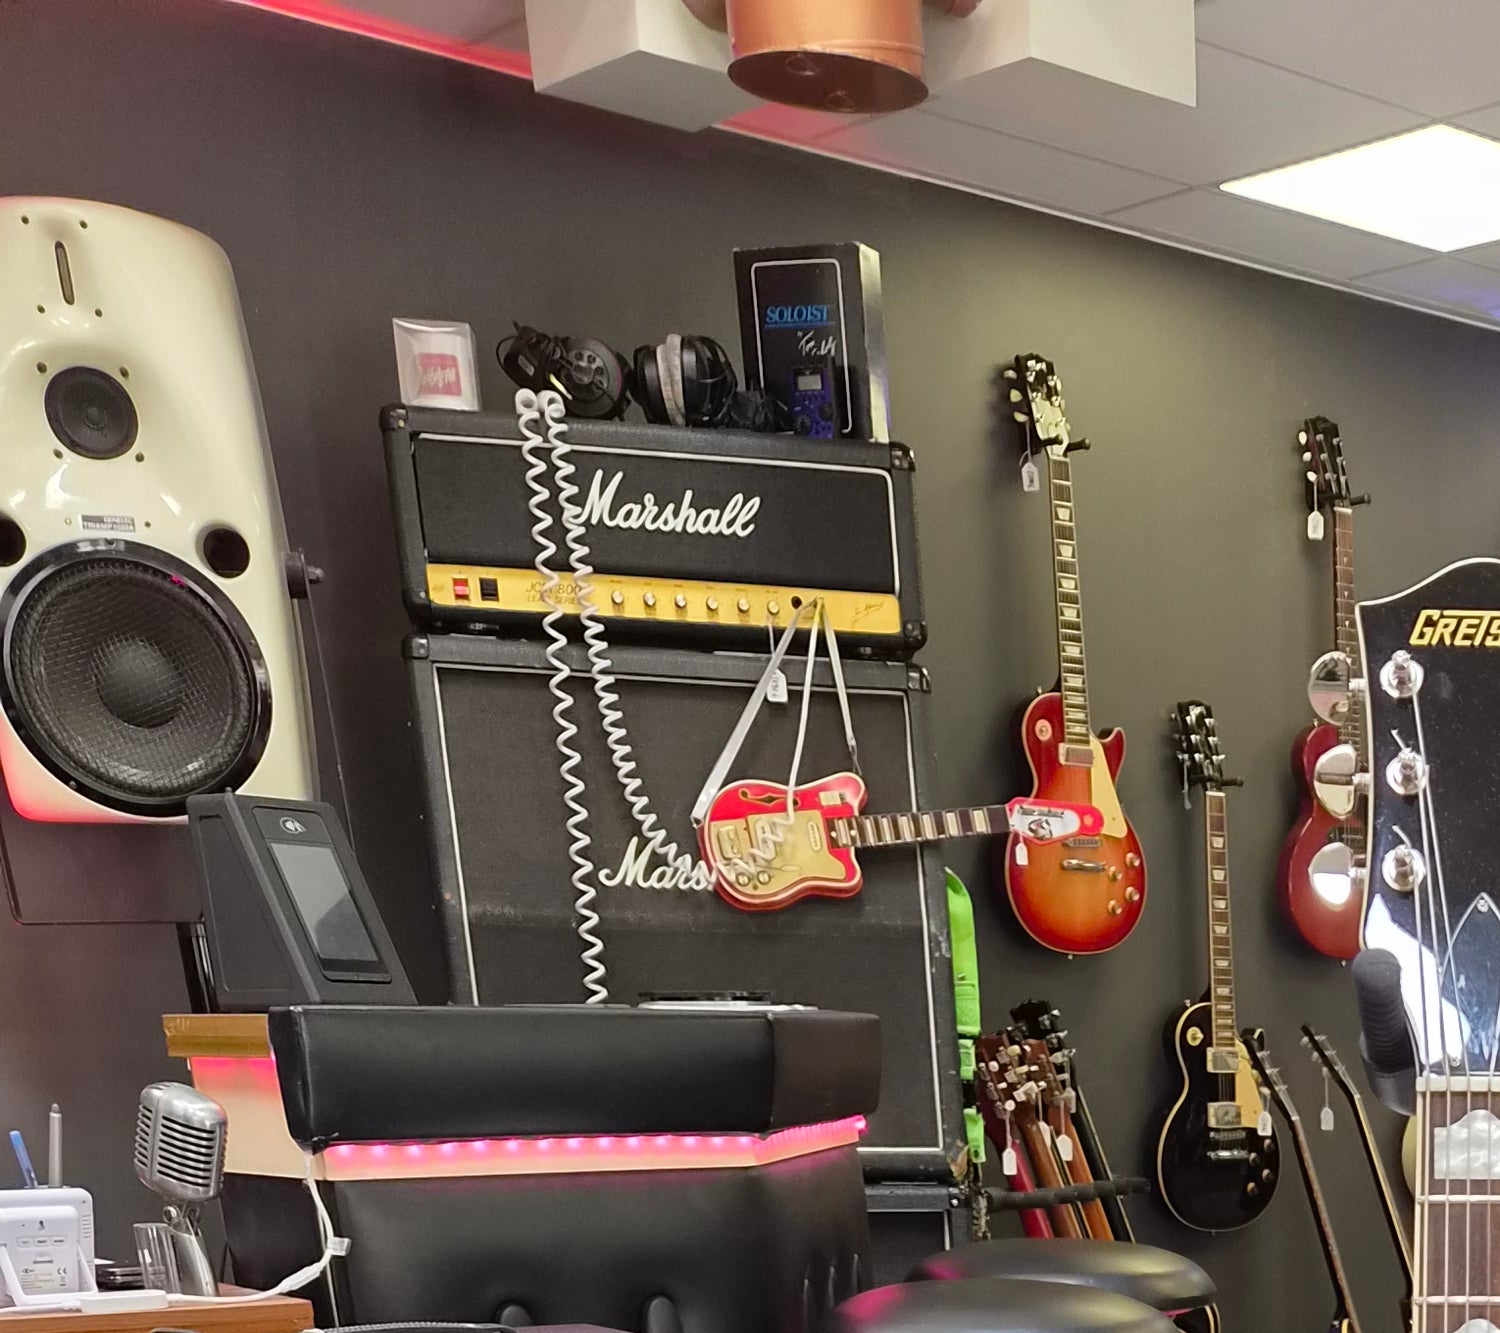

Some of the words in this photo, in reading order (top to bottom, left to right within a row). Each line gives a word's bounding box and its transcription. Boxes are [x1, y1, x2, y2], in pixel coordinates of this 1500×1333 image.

[765, 303, 833, 323] SOLOIST
[574, 469, 761, 538] Marshall
[597, 836, 717, 891] Mars
